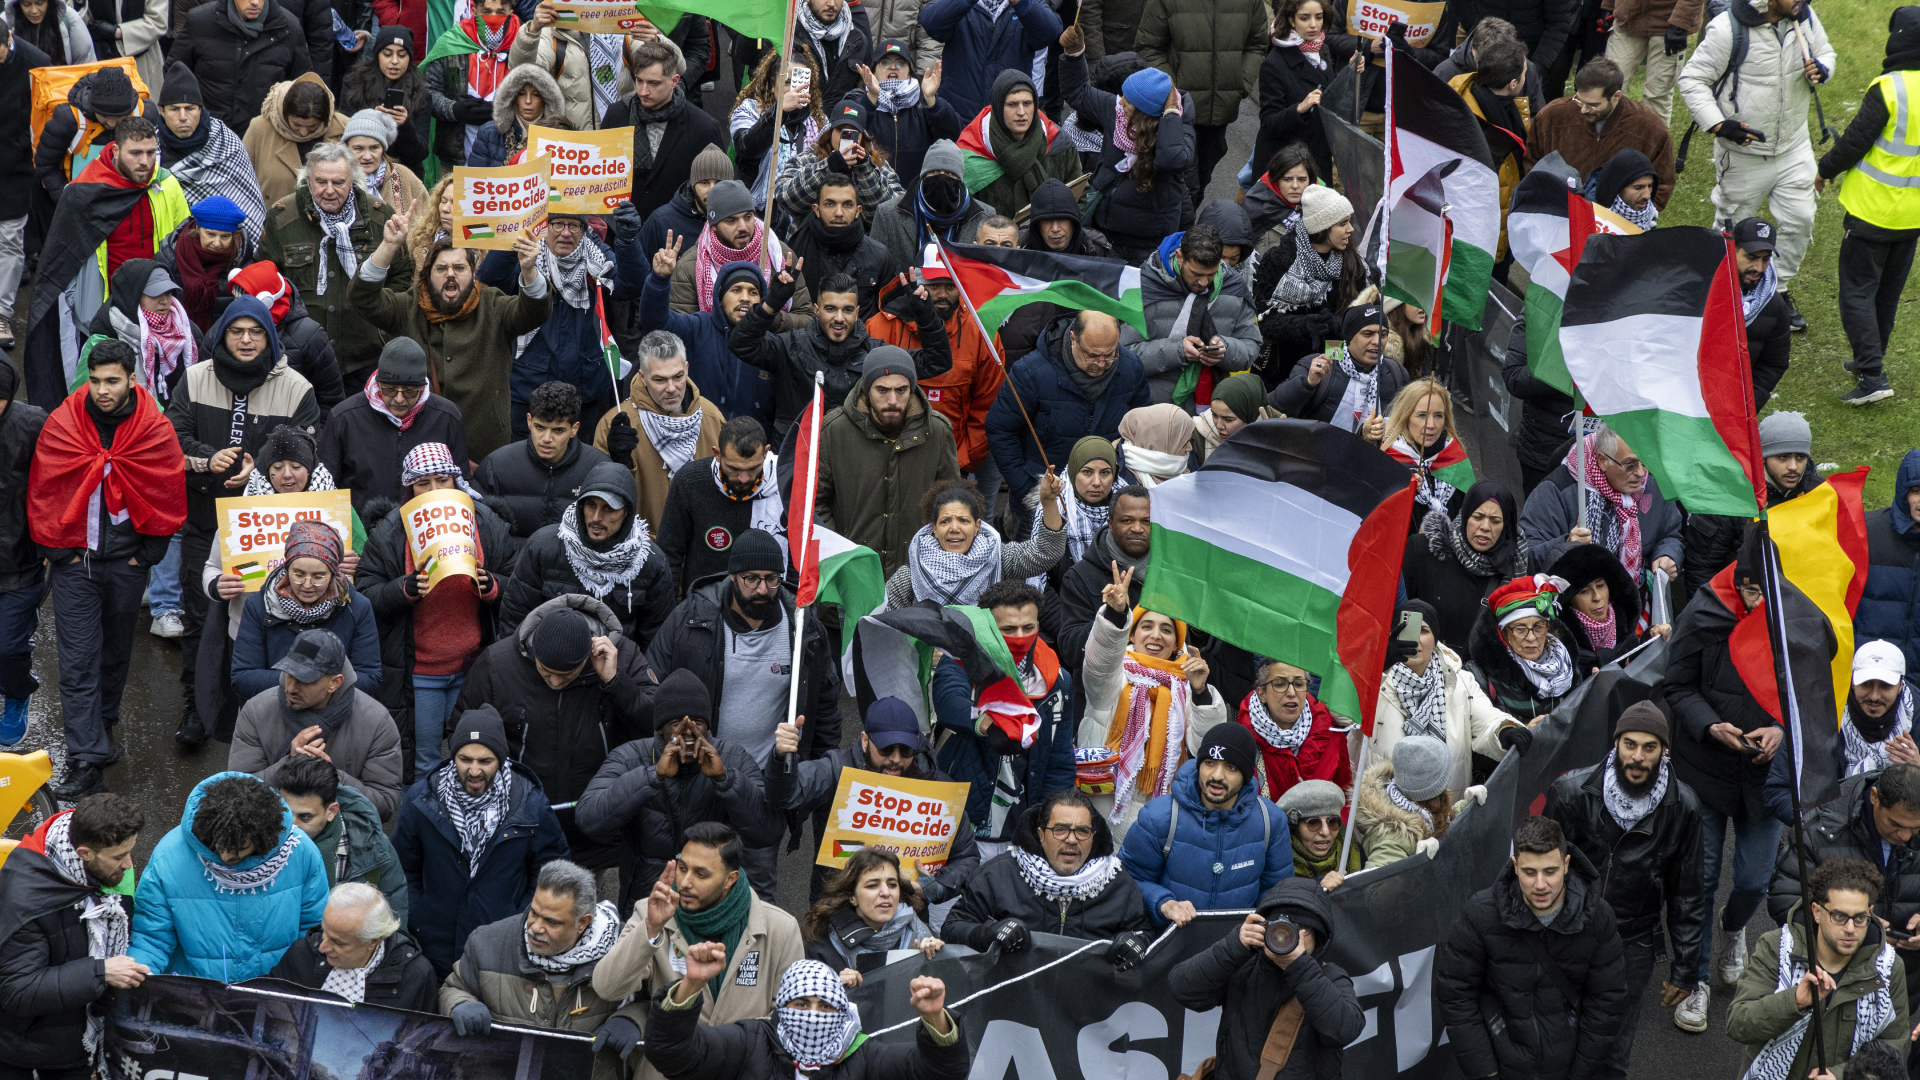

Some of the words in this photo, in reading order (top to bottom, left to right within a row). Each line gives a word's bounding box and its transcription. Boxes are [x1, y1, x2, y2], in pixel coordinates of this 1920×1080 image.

[1361, 5, 1399, 25] Stop
[1360, 19, 1429, 38] genide
[545, 144, 590, 164] Stop
[551, 159, 626, 176] enocide
[473, 180, 519, 198] Stop
[523, 176, 538, 191] au
[473, 188, 545, 215] génocide
[238, 512, 289, 529] Stop
[414, 506, 456, 528] Stop
[857, 788, 913, 816] Stop
[917, 801, 943, 816] au
[852, 809, 951, 837] génocide
